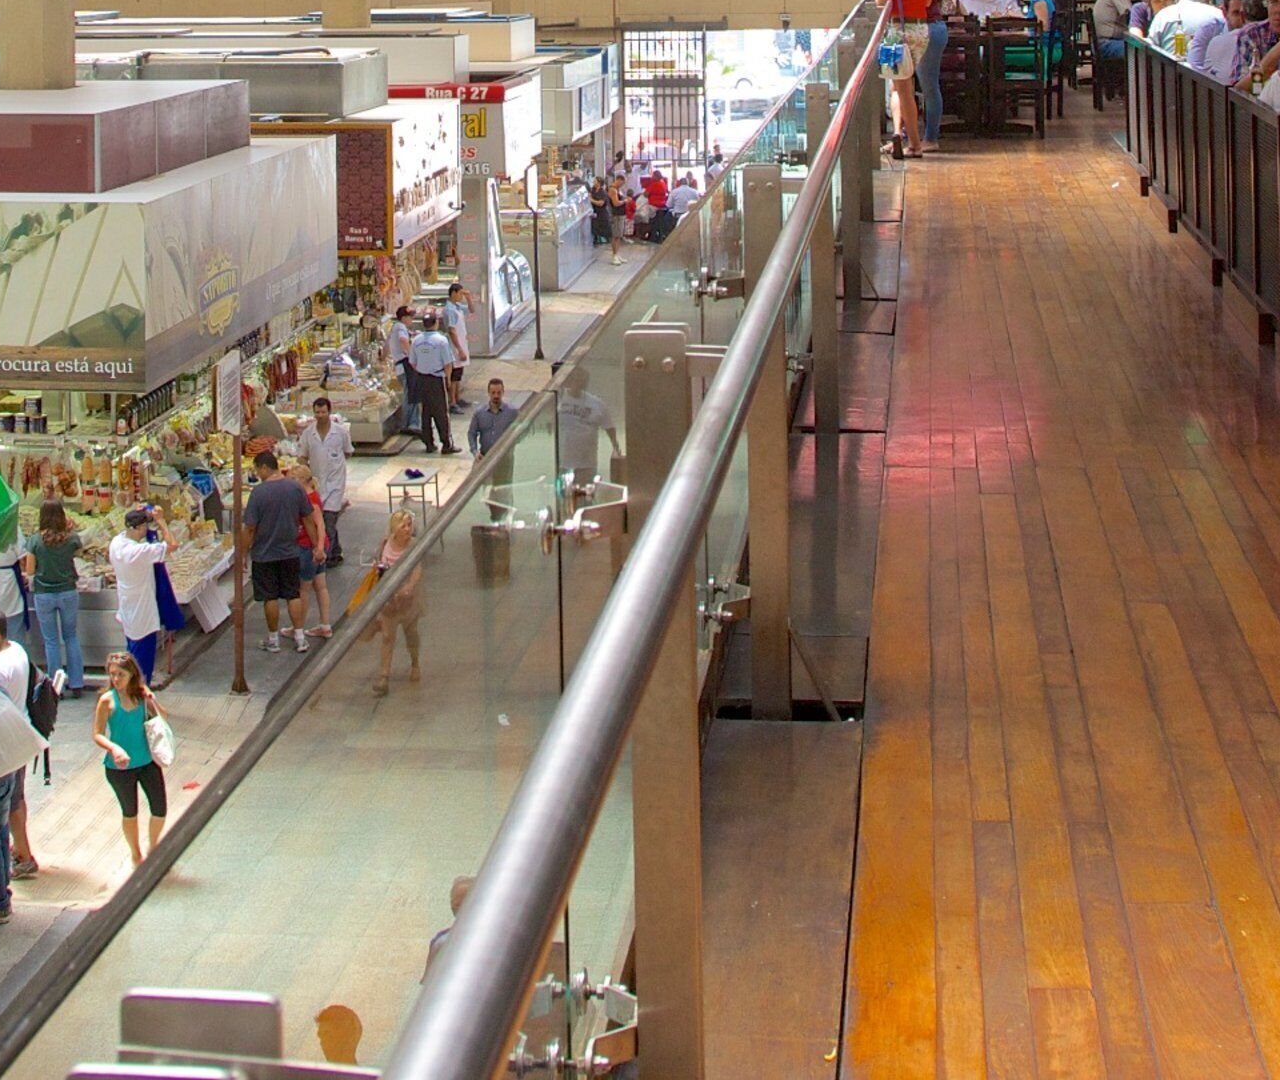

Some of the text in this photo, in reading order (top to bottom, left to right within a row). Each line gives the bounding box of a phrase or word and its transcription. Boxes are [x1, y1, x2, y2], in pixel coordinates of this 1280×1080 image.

[424, 86, 488, 100] Rua C 27
[55, 356, 89, 373] está
[94, 358, 134, 378] aqui
